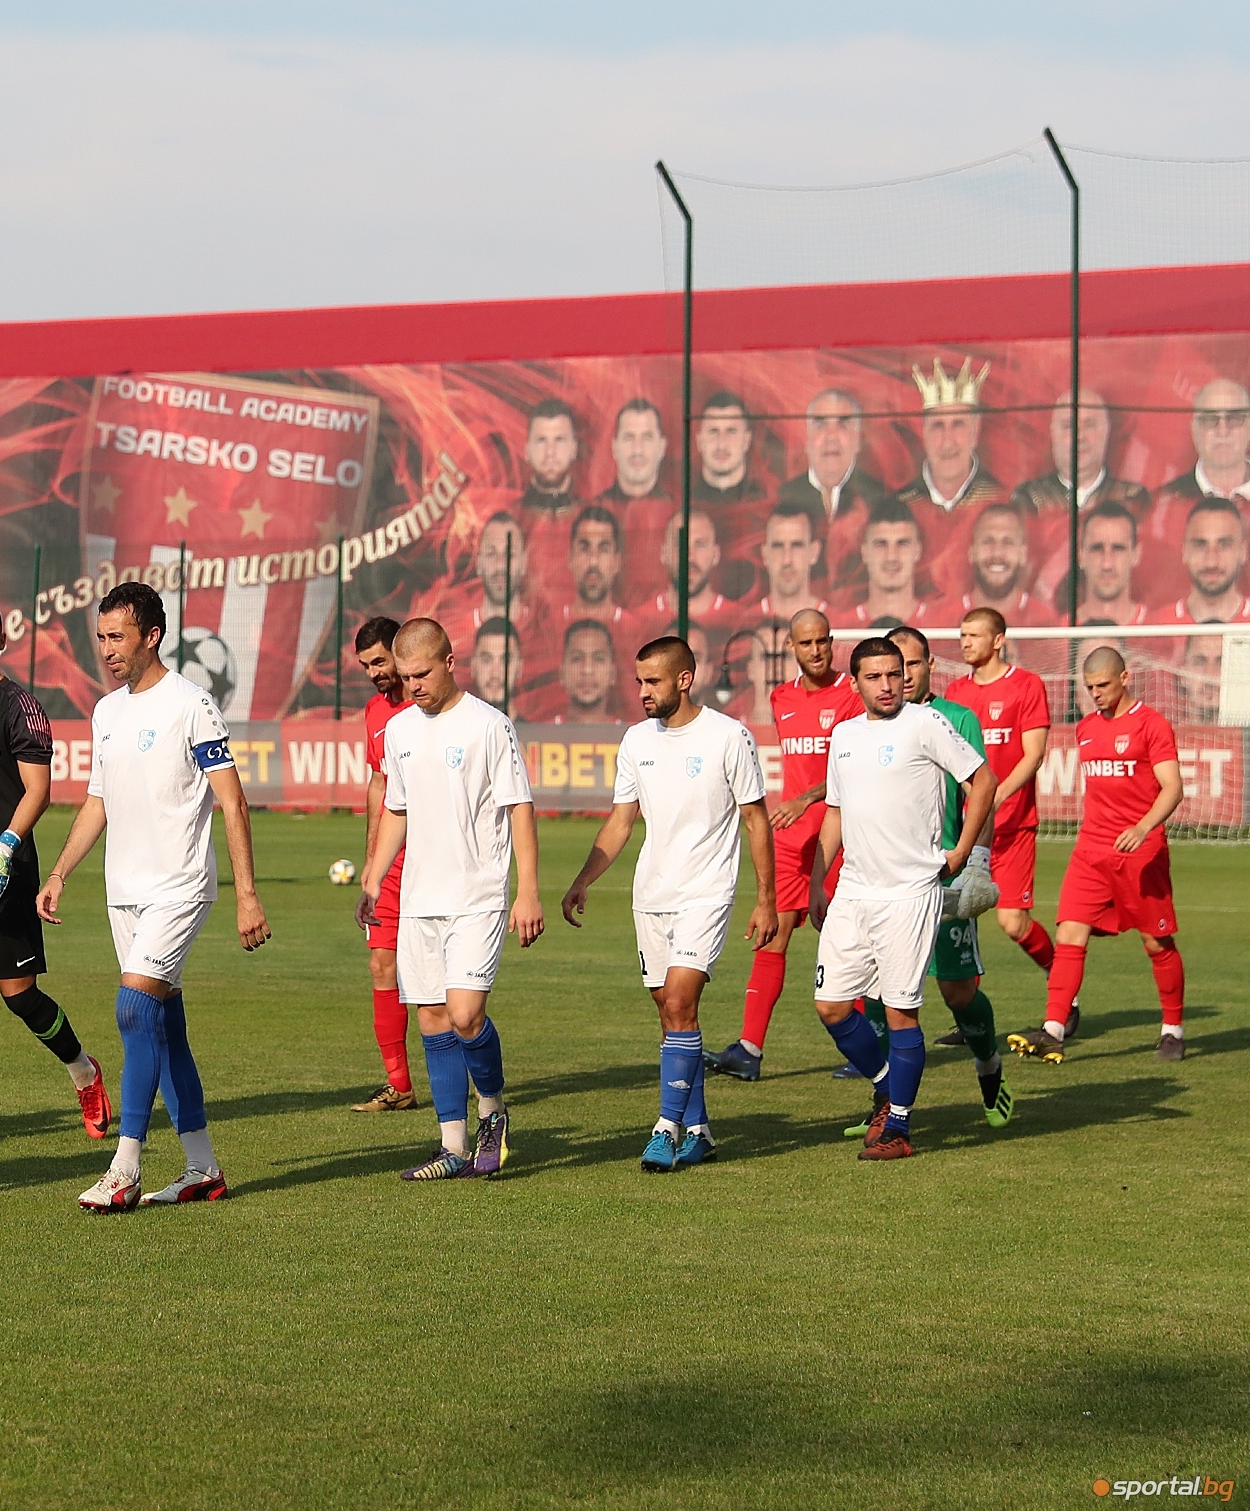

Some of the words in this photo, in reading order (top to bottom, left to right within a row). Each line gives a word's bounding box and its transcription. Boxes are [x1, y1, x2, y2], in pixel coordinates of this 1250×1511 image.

[103, 376, 234, 415] FOOTBALL
[240, 397, 369, 434] ACADEMY
[96, 421, 258, 473] TSARSKO
[267, 448, 363, 488] SELO
[235, 451, 468, 587] историята!
[288, 740, 372, 785] WIN
